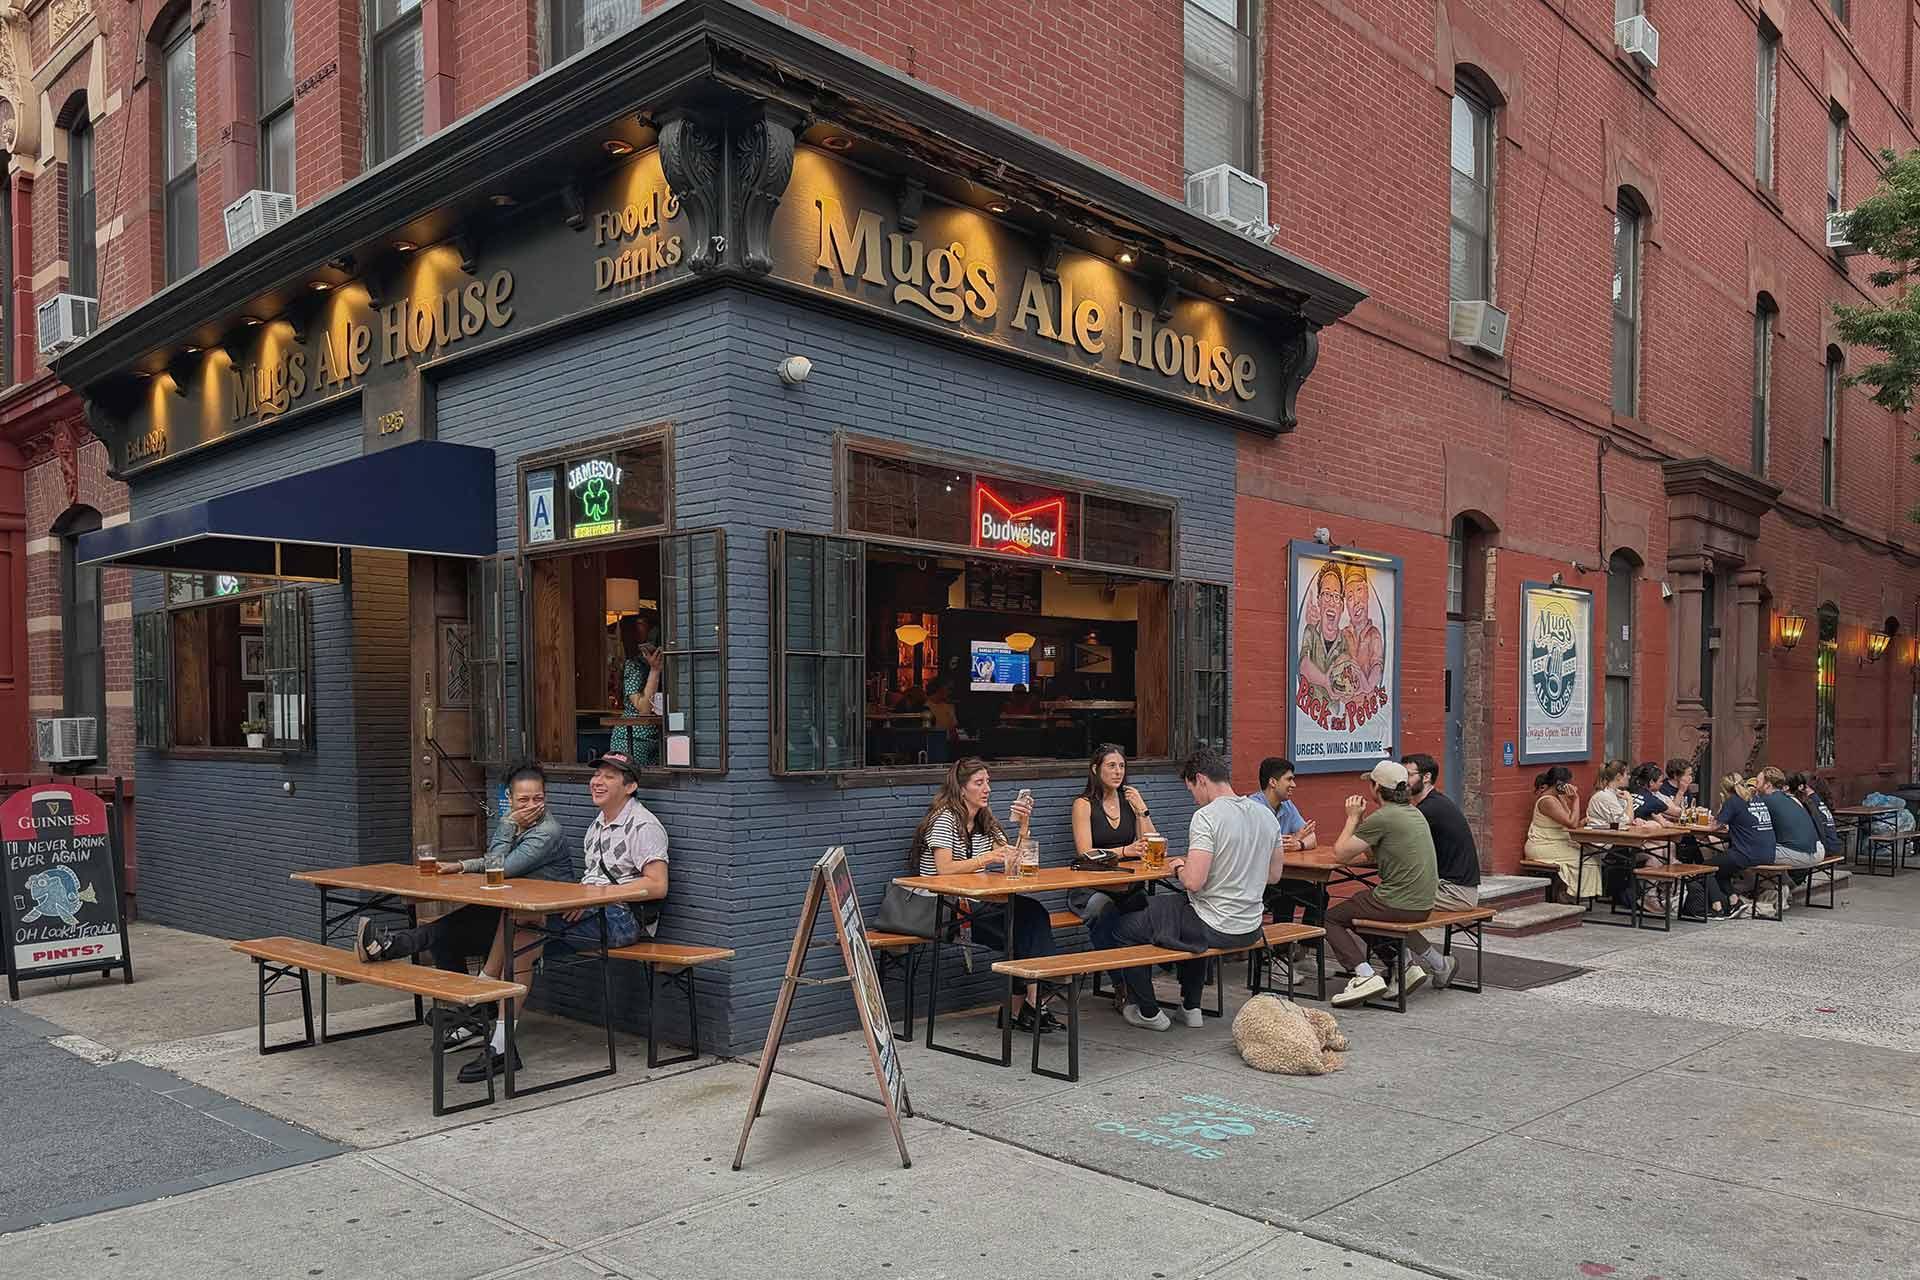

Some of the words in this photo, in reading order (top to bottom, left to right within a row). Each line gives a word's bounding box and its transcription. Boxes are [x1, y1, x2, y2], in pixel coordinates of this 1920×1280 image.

[593, 191, 658, 246] Food
[594, 234, 682, 291] Drinks
[815, 197, 997, 322] Mugs
[1010, 268, 1106, 354] Ale
[1119, 301, 1257, 400] House
[232, 350, 306, 421] Mugs
[313, 320, 371, 390] Ale
[380, 270, 513, 366] House
[534, 495, 549, 527] A
[982, 513, 1056, 546] Budweiser
[1296, 673, 1332, 731] Rick
[1345, 685, 1388, 733] Pete's
[1535, 682, 1548, 709] ALE
[1551, 681, 1573, 713] HOUSE
[1297, 743, 1325, 756] URGERS,
[1326, 742, 1348, 754] WINGS
[1349, 742, 1363, 753] AND
[1364, 741, 1382, 752] MORE
[18, 814, 90, 830] GUINNESS
[11, 854, 45, 870] EVER
[28, 840, 67, 854] NEVER
[15, 927, 37, 943] OH
[33, 944, 104, 961] PINTS?
